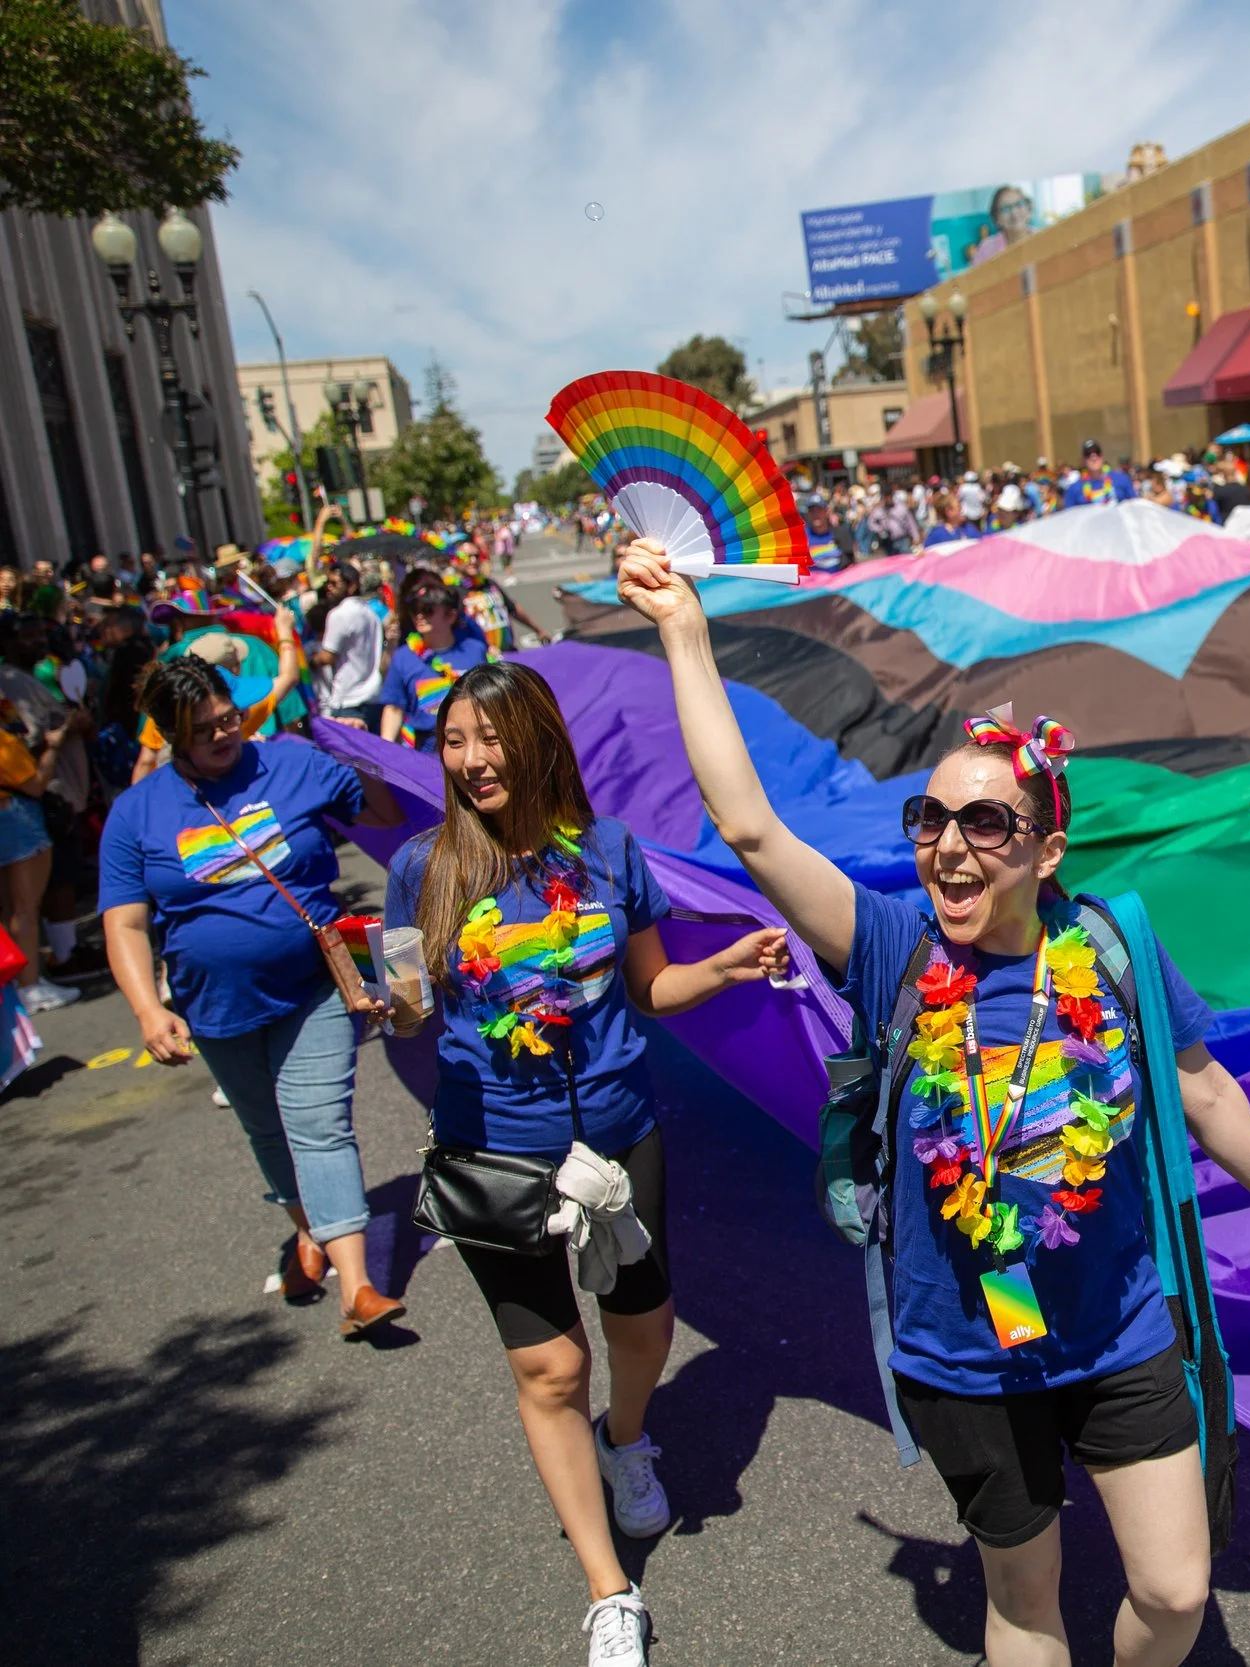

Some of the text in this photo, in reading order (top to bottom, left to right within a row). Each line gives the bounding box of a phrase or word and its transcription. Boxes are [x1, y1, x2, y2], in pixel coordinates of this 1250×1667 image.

[1017, 1038, 1030, 1069] SPECTRUM
[1019, 1007, 1045, 1085] BUSINESS RESOURCE GROUP
[1010, 1325, 1035, 1340] ally.
